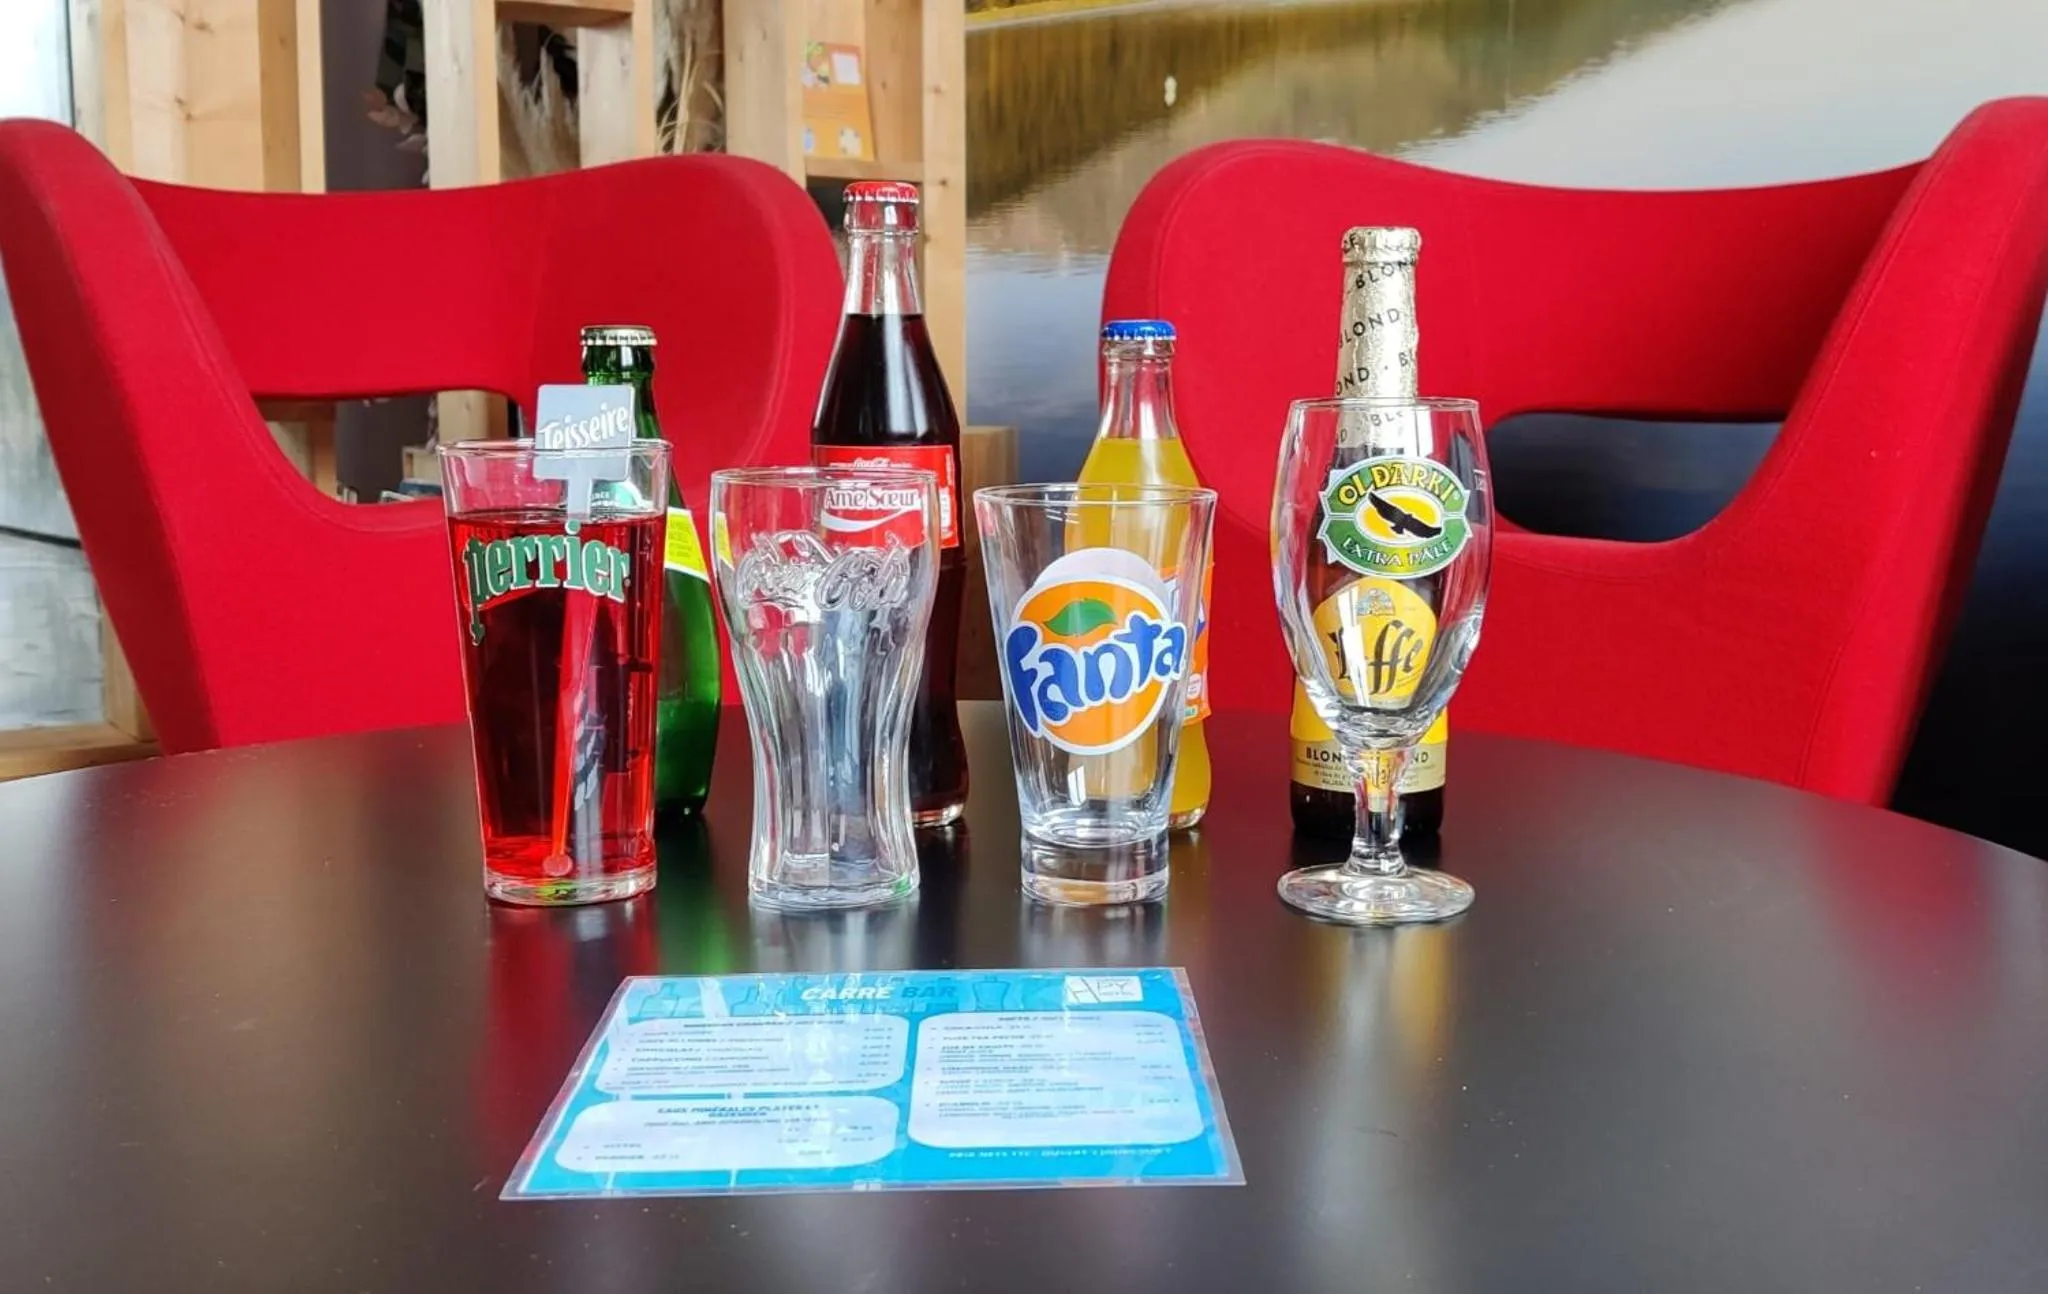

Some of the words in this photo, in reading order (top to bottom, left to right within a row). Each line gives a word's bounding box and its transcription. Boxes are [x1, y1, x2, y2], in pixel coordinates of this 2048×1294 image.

[539, 402, 628, 449] Teisseire
[1341, 536, 1402, 566] EXTRA
[1408, 540, 1453, 566] PALE
[1004, 612, 1187, 738] Fanta
[1327, 619, 1424, 696] Lffe
[1305, 747, 1344, 763] BLON
[901, 986, 957, 998] BAR
